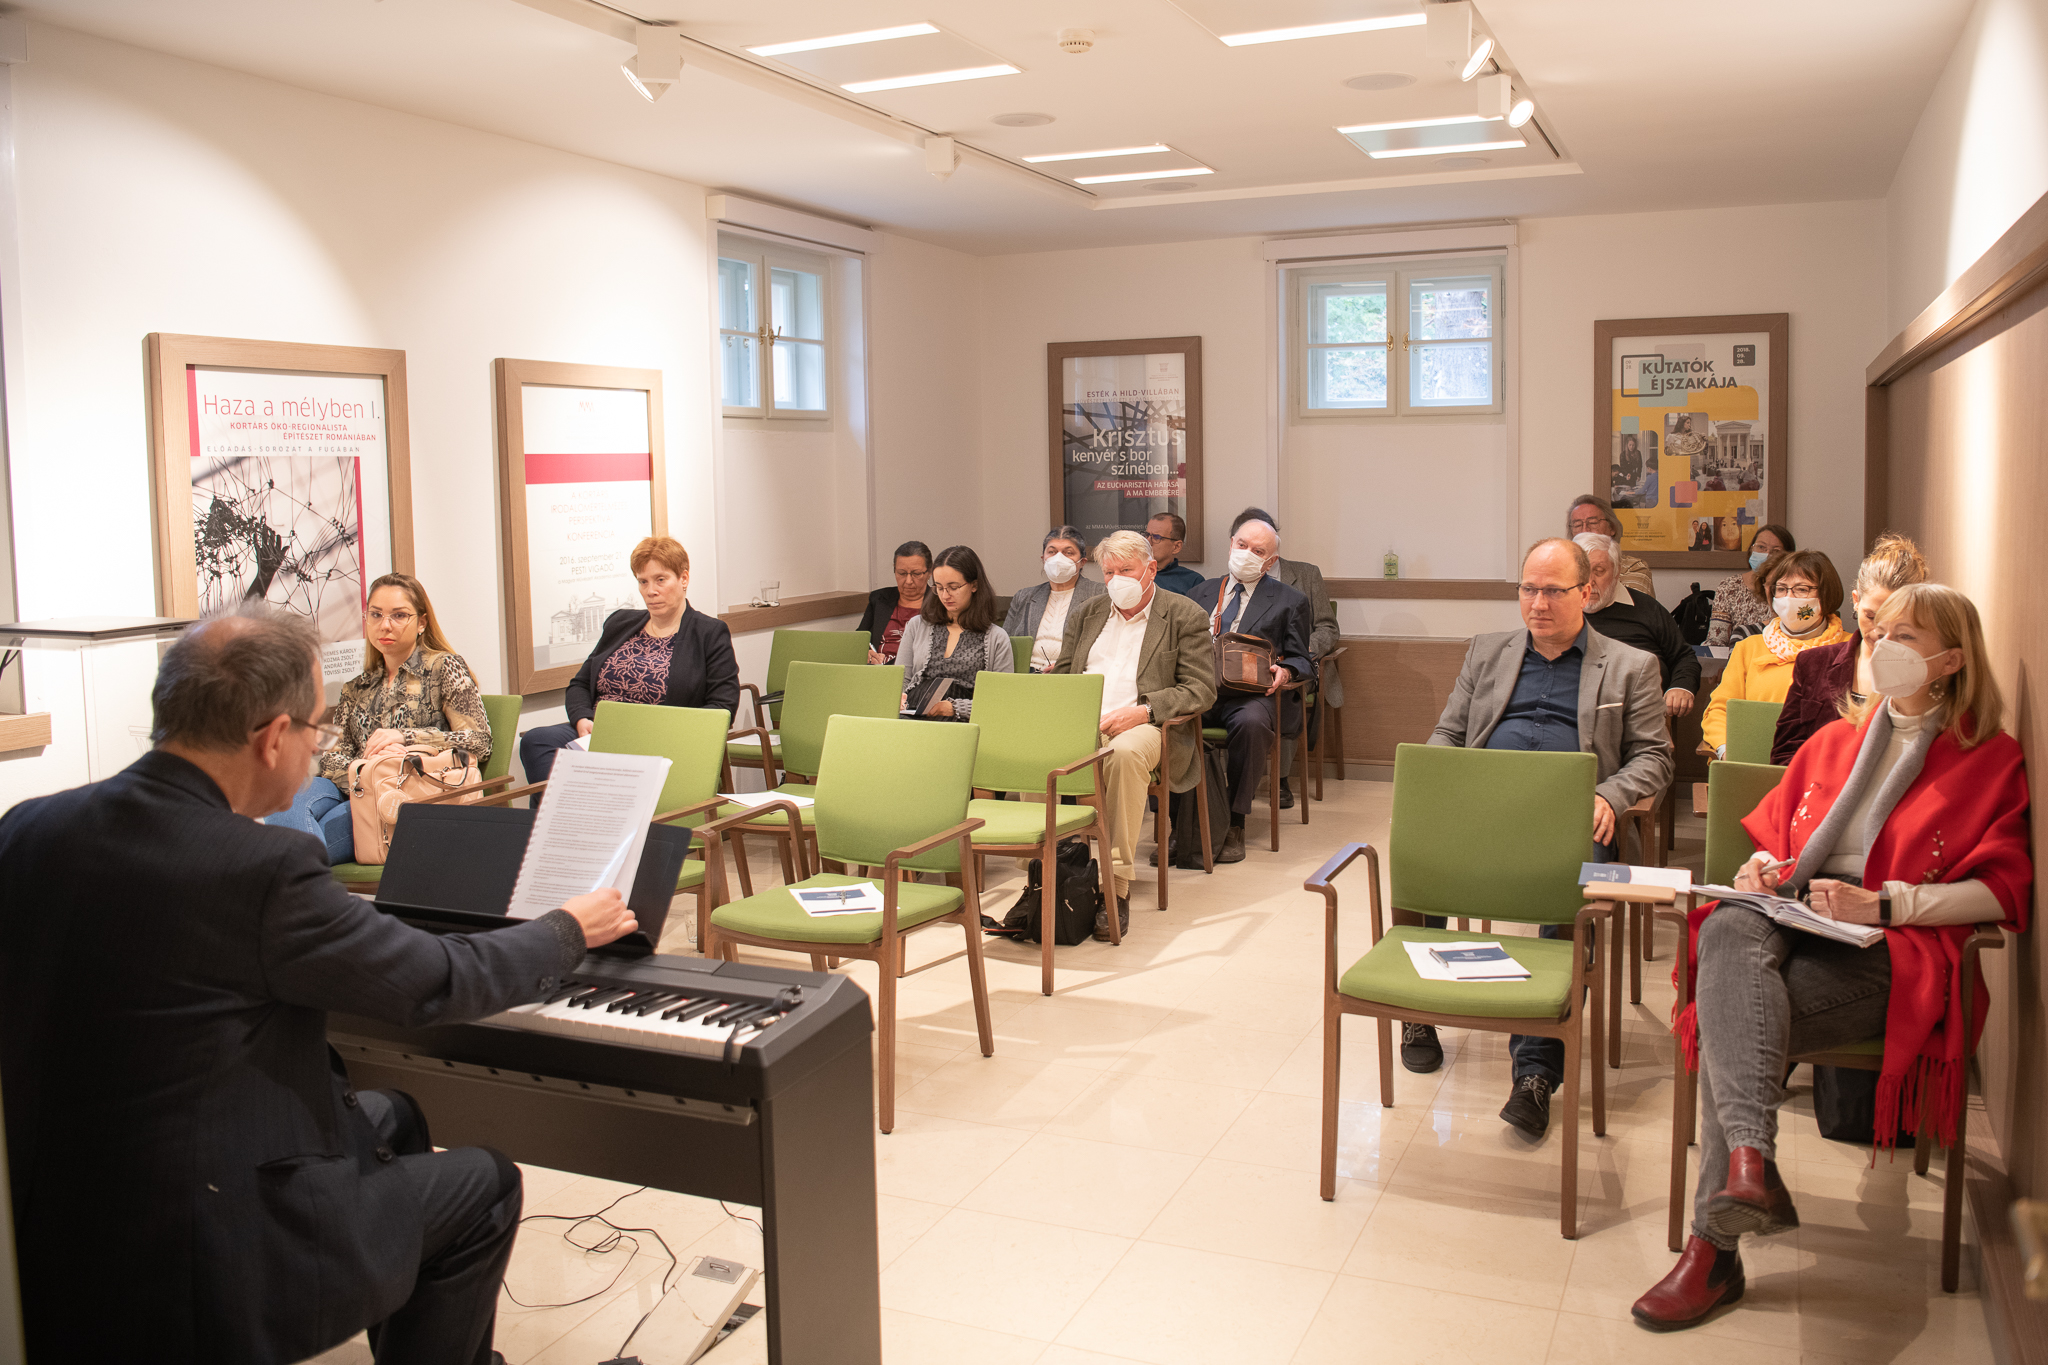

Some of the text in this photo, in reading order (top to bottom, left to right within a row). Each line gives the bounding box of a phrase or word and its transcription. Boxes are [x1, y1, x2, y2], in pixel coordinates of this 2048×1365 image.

[1642, 357, 1714, 375] KUTATÓK
[1651, 373, 1738, 390] ÉJSZAKÁJA
[1086, 389, 1110, 398] ESTÉK
[1120, 388, 1180, 397] HILD-VILLÁBAN
[203, 394, 380, 421] Haza a mélyben I.
[230, 420, 348, 431] KORTÁRS ÖKO-REGIONALISTA
[283, 431, 377, 441] ÉPÍTÉSZET ROMÁNIÁBAN
[307, 445, 313, 453] A
[318, 445, 360, 453] FUGÁBAN
[1072, 448, 1153, 464] kenyér s bor
[1111, 462, 1179, 475] színében...
[1107, 481, 1153, 489] EUCHARISZTIA
[1154, 480, 1180, 488] HATÁSA
[1126, 489, 1132, 497] A
[1145, 488, 1180, 496] EMBERÉRE
[567, 530, 615, 541] KONFERENCIA
[559, 556, 576, 565] 2016.
[578, 553, 614, 564] szeptember
[571, 562, 615, 575] PESTI VIGADÓ
[342, 666, 355, 674] ZSOLT
